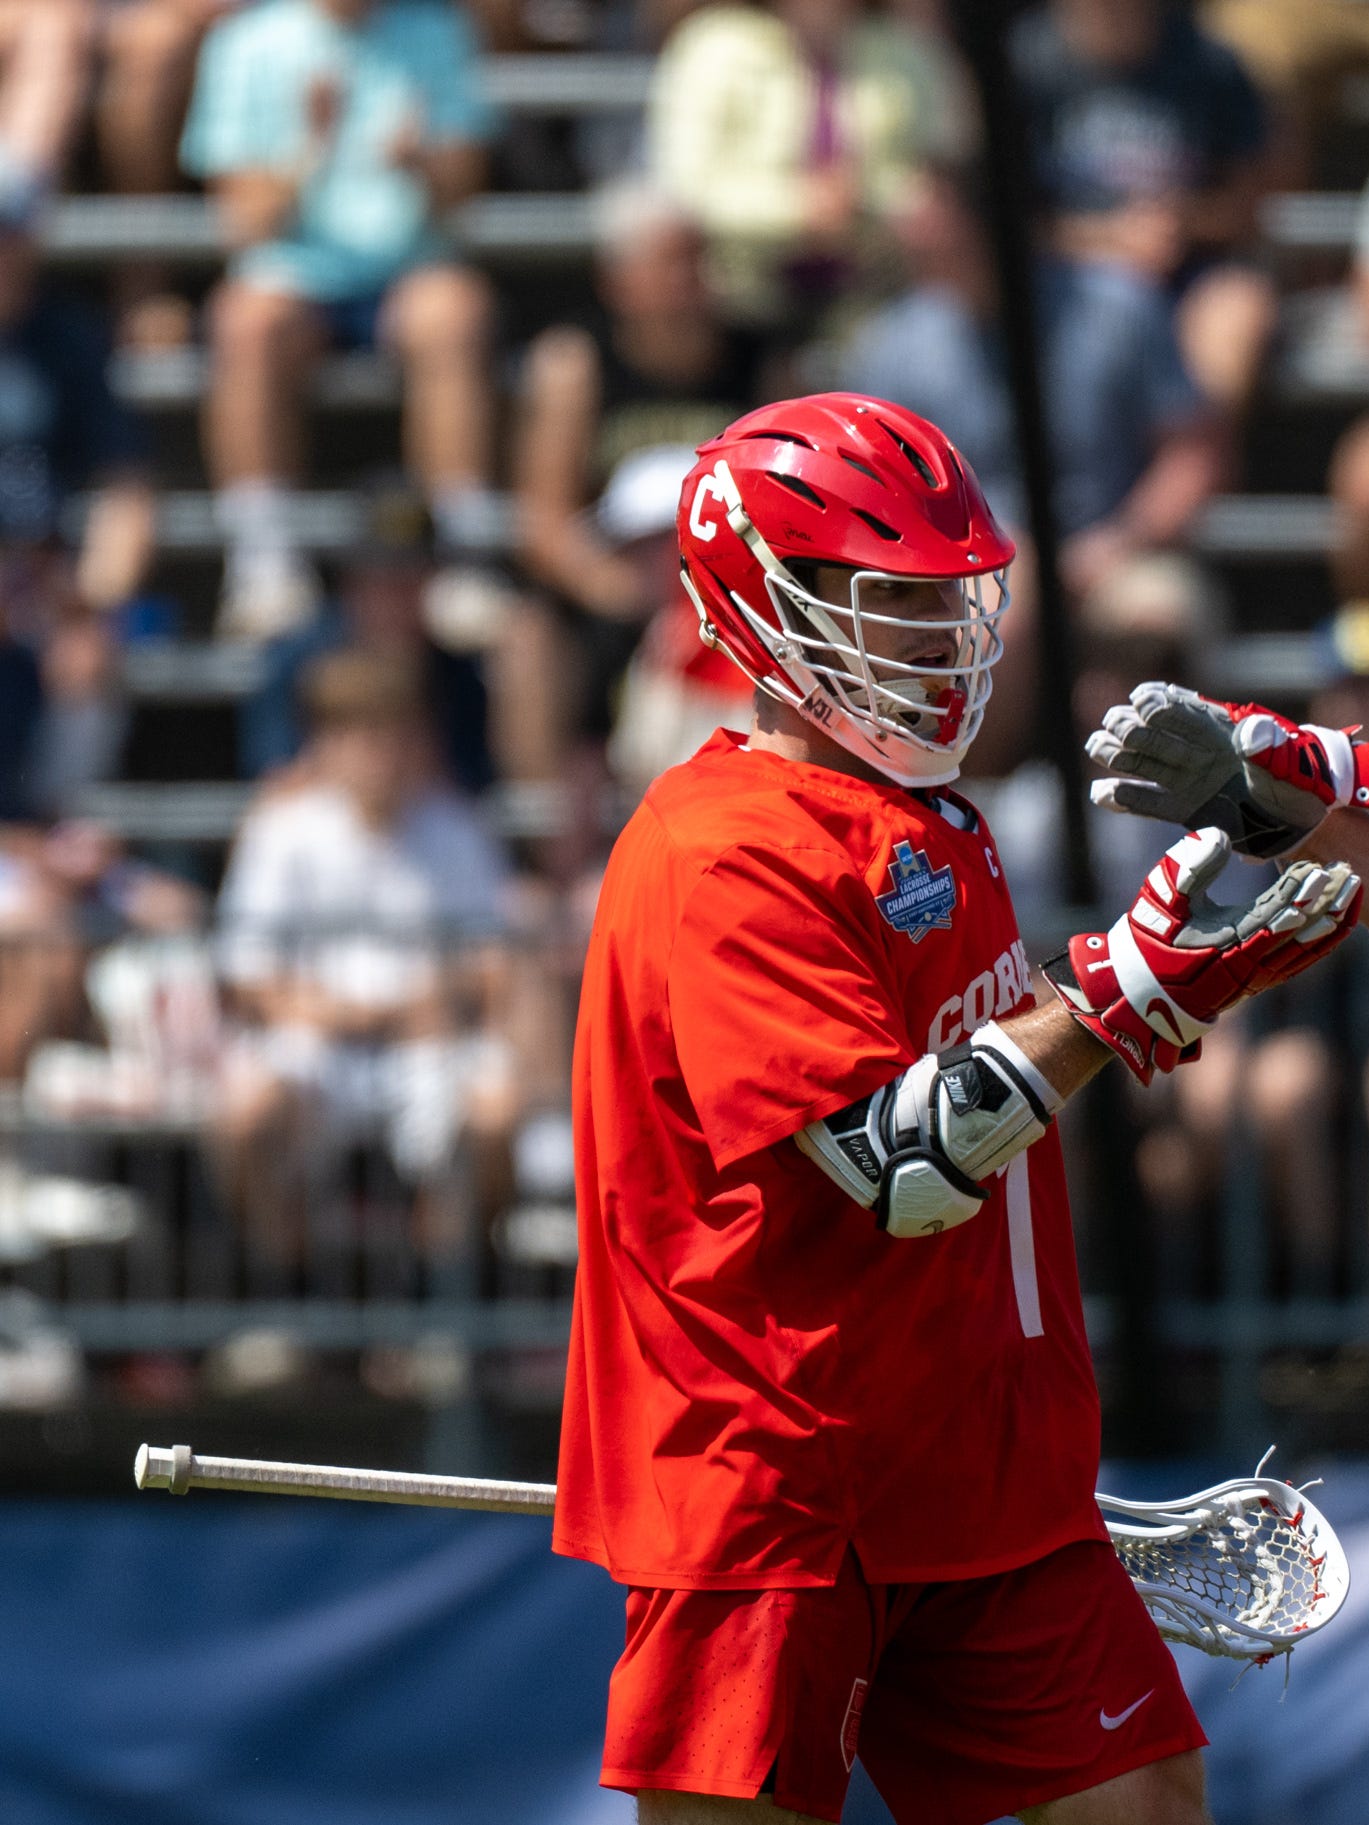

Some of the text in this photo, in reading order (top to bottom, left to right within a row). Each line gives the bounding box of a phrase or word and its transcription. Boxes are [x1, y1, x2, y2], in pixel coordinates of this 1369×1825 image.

[689, 473, 727, 542] C
[984, 846, 999, 878] C
[886, 877, 951, 915] CHAMPIONSHIPS
[899, 873, 931, 894] LACROSSE
[944, 1074, 969, 1105] NIKE
[847, 1137, 879, 1178] VAPOR
